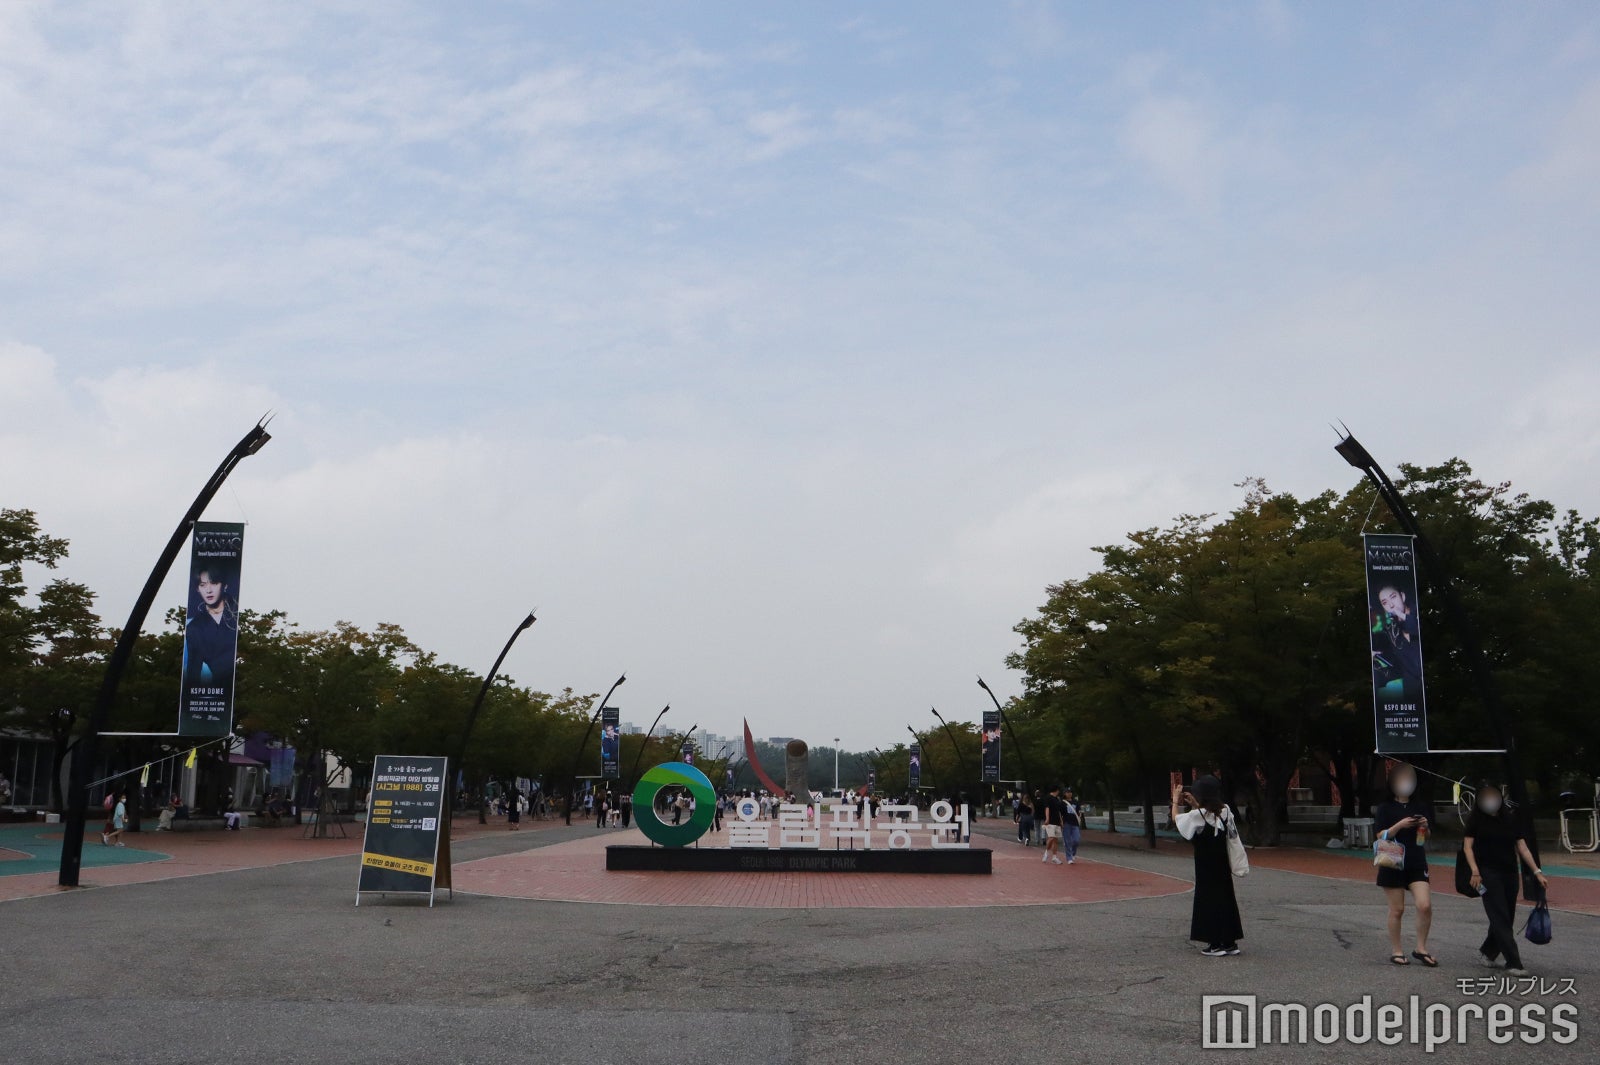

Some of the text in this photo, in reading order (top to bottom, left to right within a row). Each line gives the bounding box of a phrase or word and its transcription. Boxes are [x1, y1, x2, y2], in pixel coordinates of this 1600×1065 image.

[1368, 550, 1412, 562] MANIAC
[207, 687, 224, 695] DOME
[376, 783, 400, 791] [시그널
[424, 784, 439, 792] 오픈
[727, 797, 970, 851] 올림픽공원
[366, 857, 384, 866] 한정판
[741, 855, 763, 868] SEOUL
[789, 856, 829, 868] OLYMPIC
[831, 857, 857, 869] PARK
